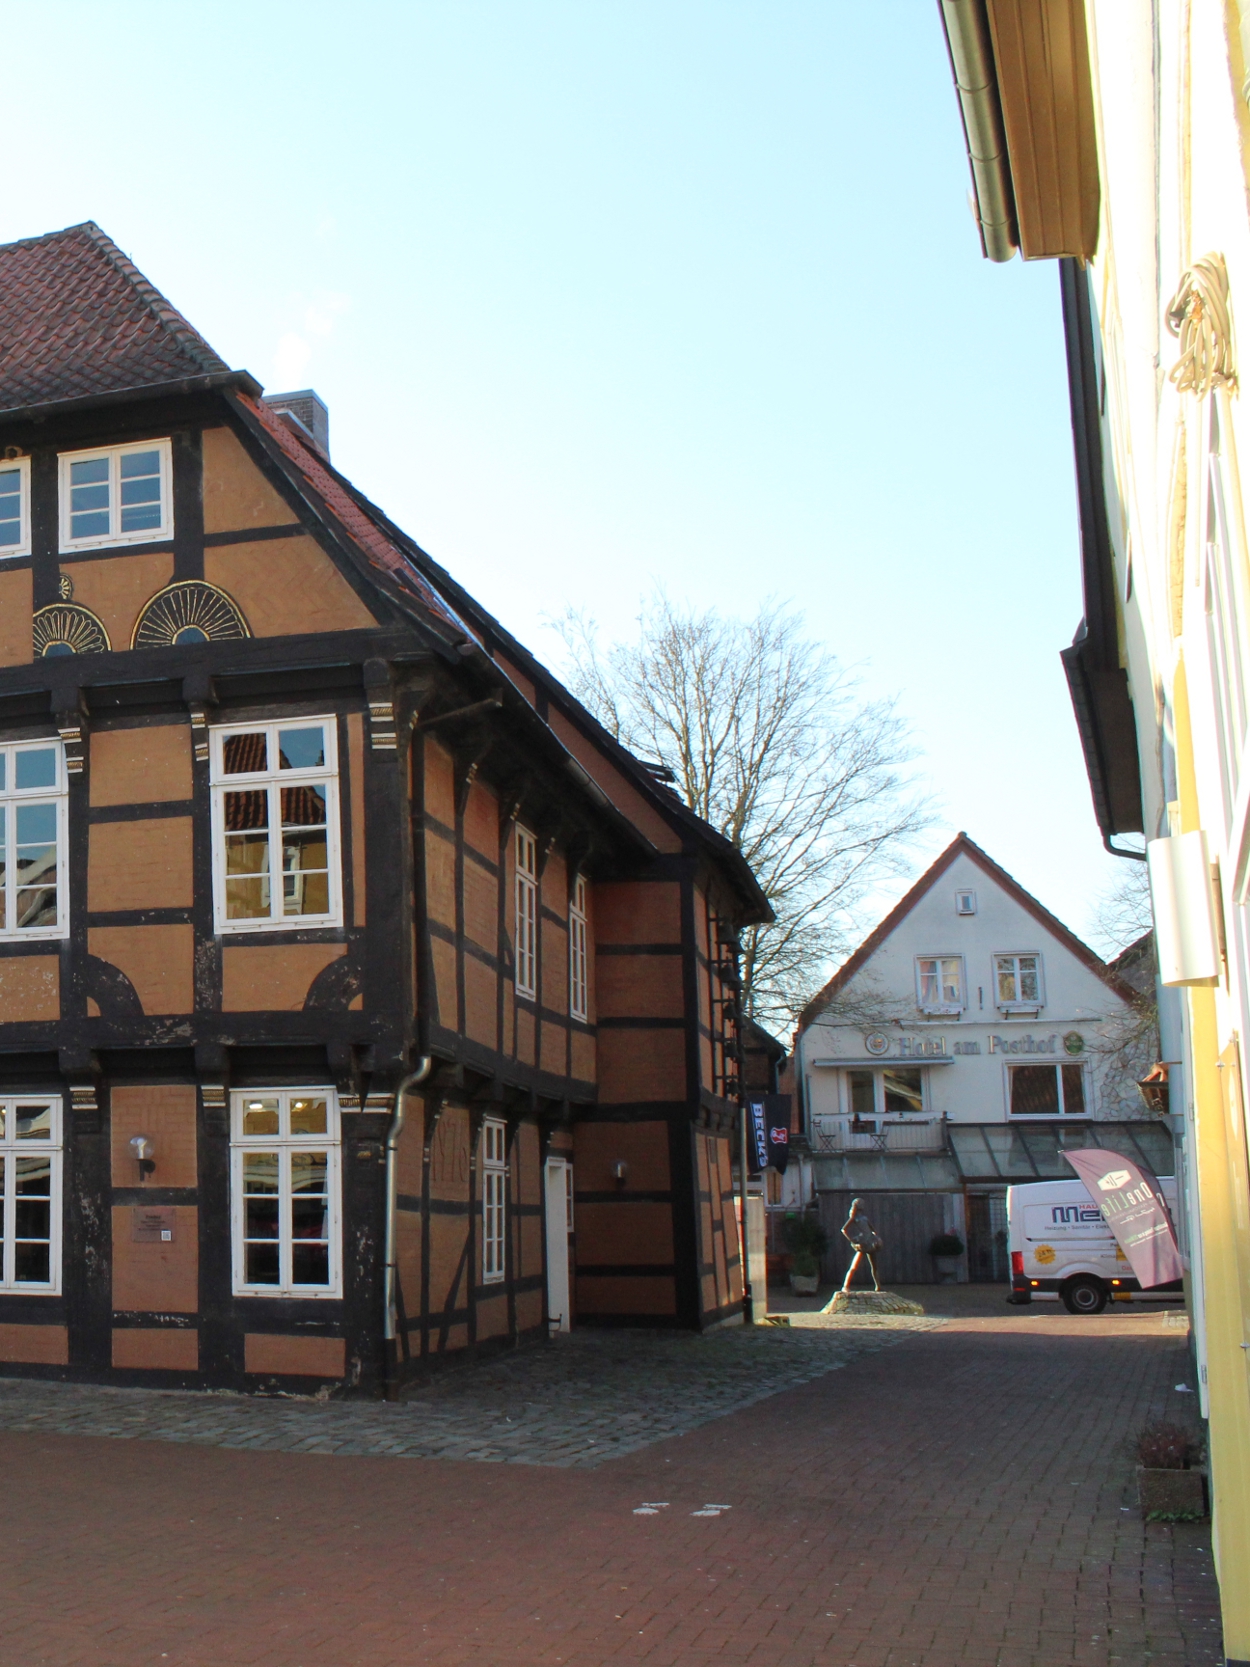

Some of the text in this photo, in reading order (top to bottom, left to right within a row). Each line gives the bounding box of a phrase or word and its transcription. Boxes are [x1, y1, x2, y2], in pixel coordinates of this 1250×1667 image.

[898, 1036, 947, 1056] Hotel
[953, 1040, 981, 1056] am
[987, 1034, 1057, 1055] Posthof
